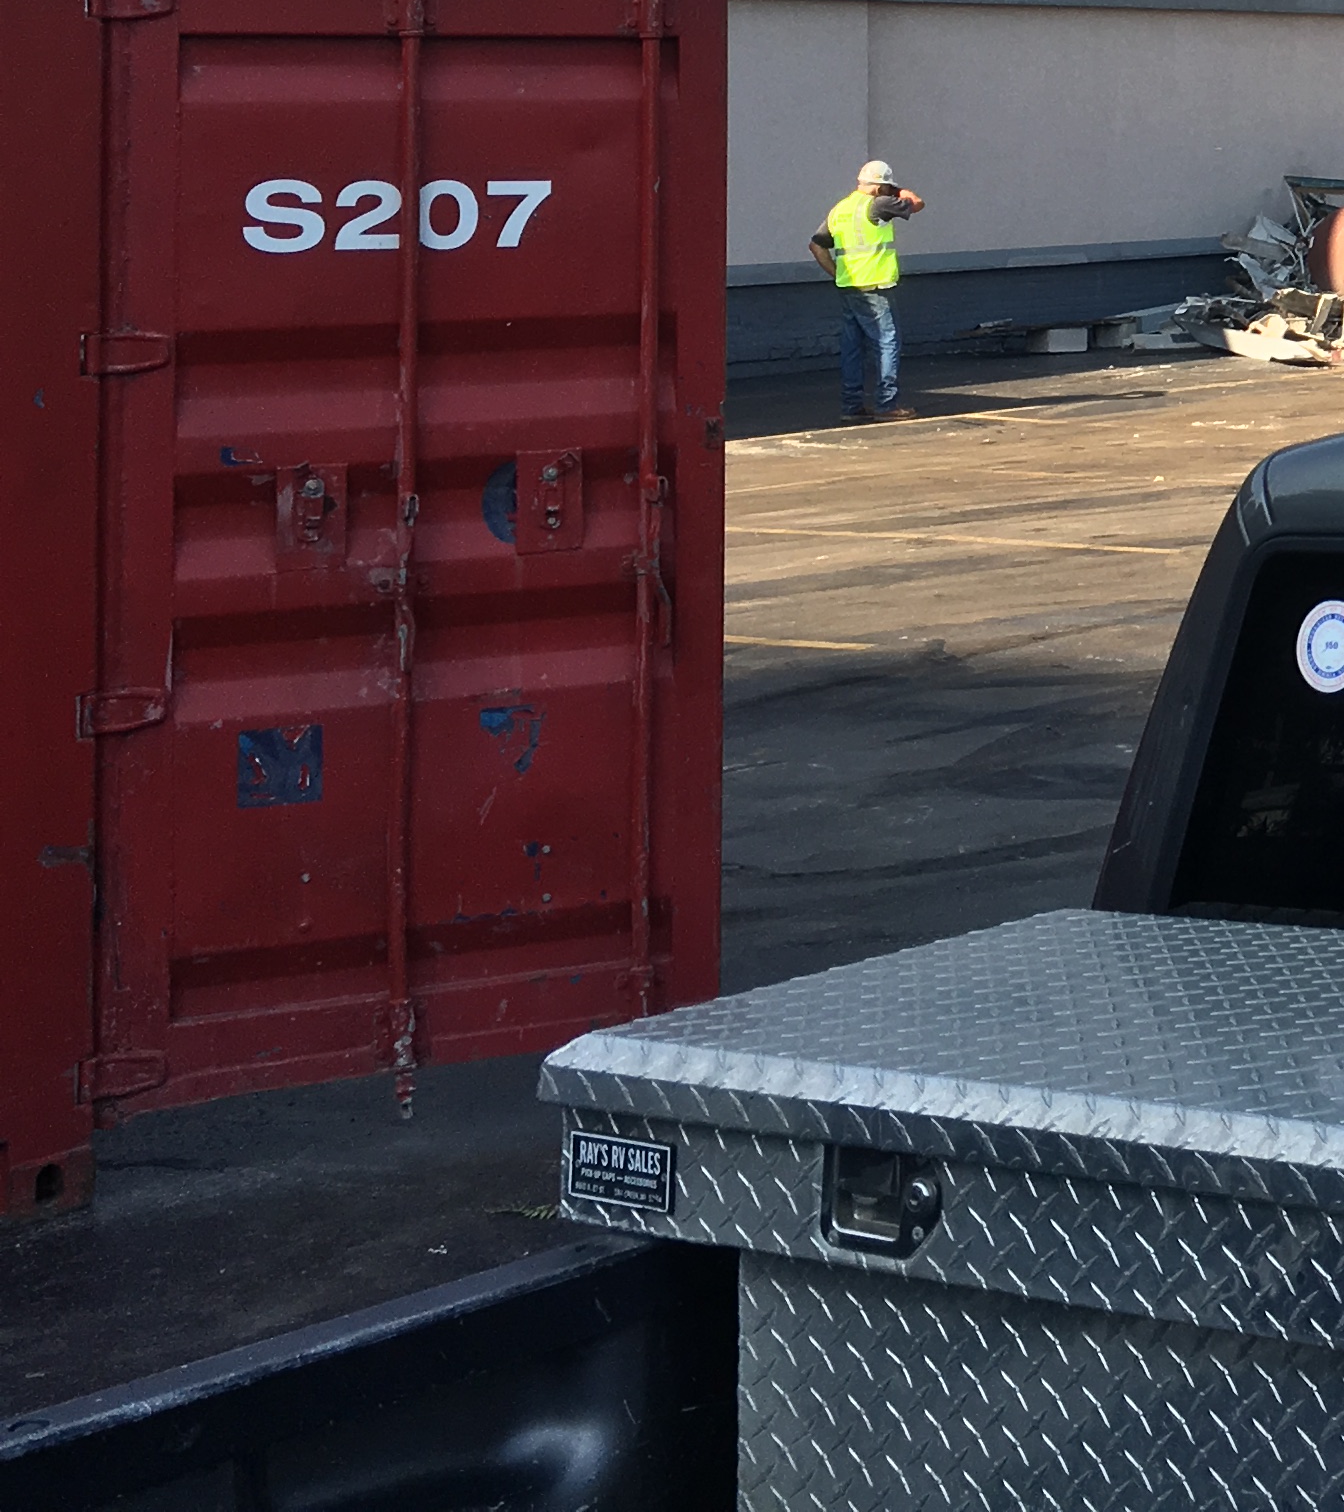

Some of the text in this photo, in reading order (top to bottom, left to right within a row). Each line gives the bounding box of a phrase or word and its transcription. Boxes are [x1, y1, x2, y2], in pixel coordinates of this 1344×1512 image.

[242, 179, 552, 254] S207
[580, 1140, 661, 1175] RAY'S RV SALES
